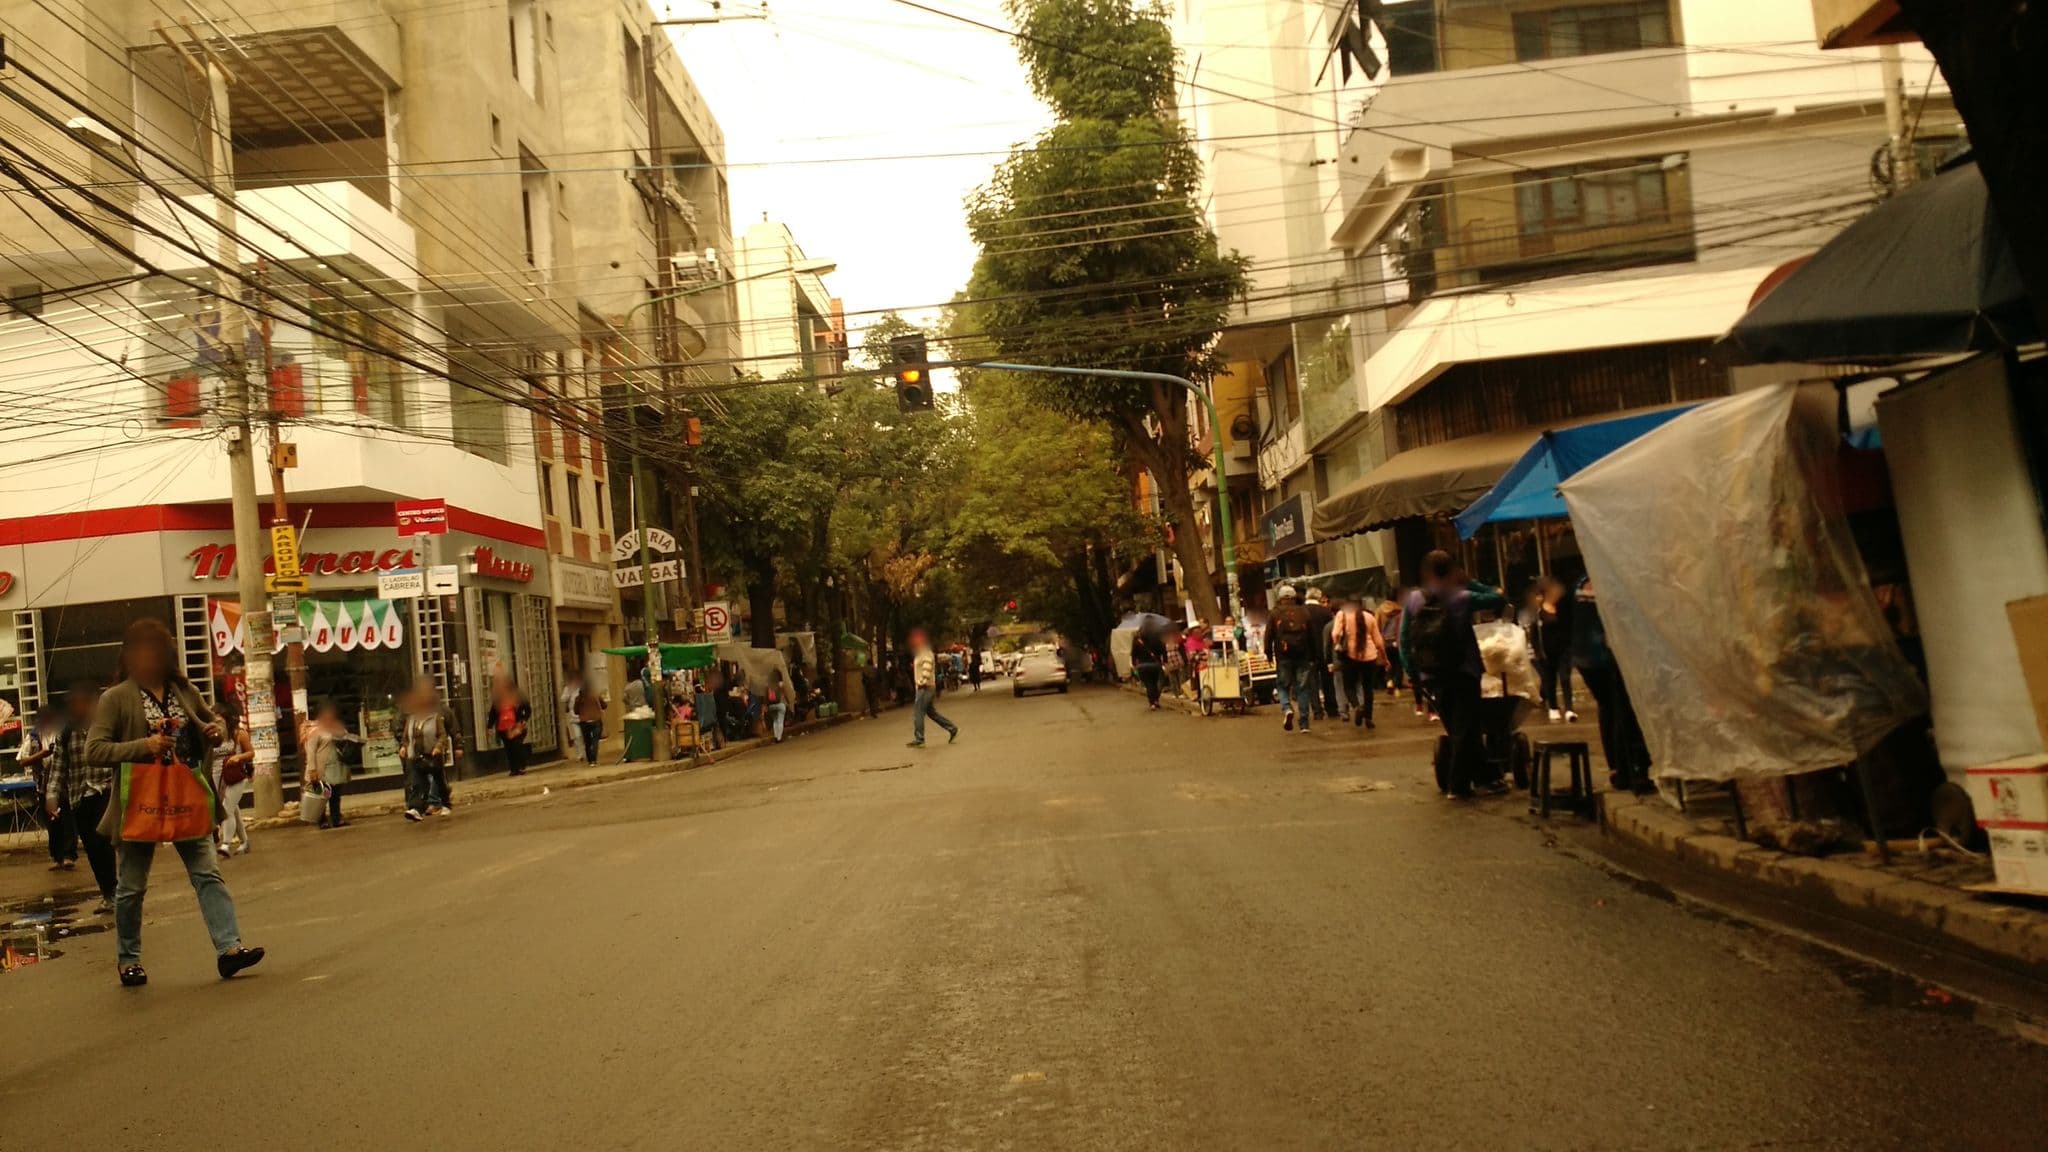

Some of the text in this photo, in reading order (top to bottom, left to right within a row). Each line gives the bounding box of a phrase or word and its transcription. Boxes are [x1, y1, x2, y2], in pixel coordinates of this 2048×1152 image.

[276, 527, 295, 577] PARQUEO
[616, 532, 674, 557] JOYRIA
[615, 562, 682, 585] VAGAS
[383, 582, 420, 591] CABRERA
